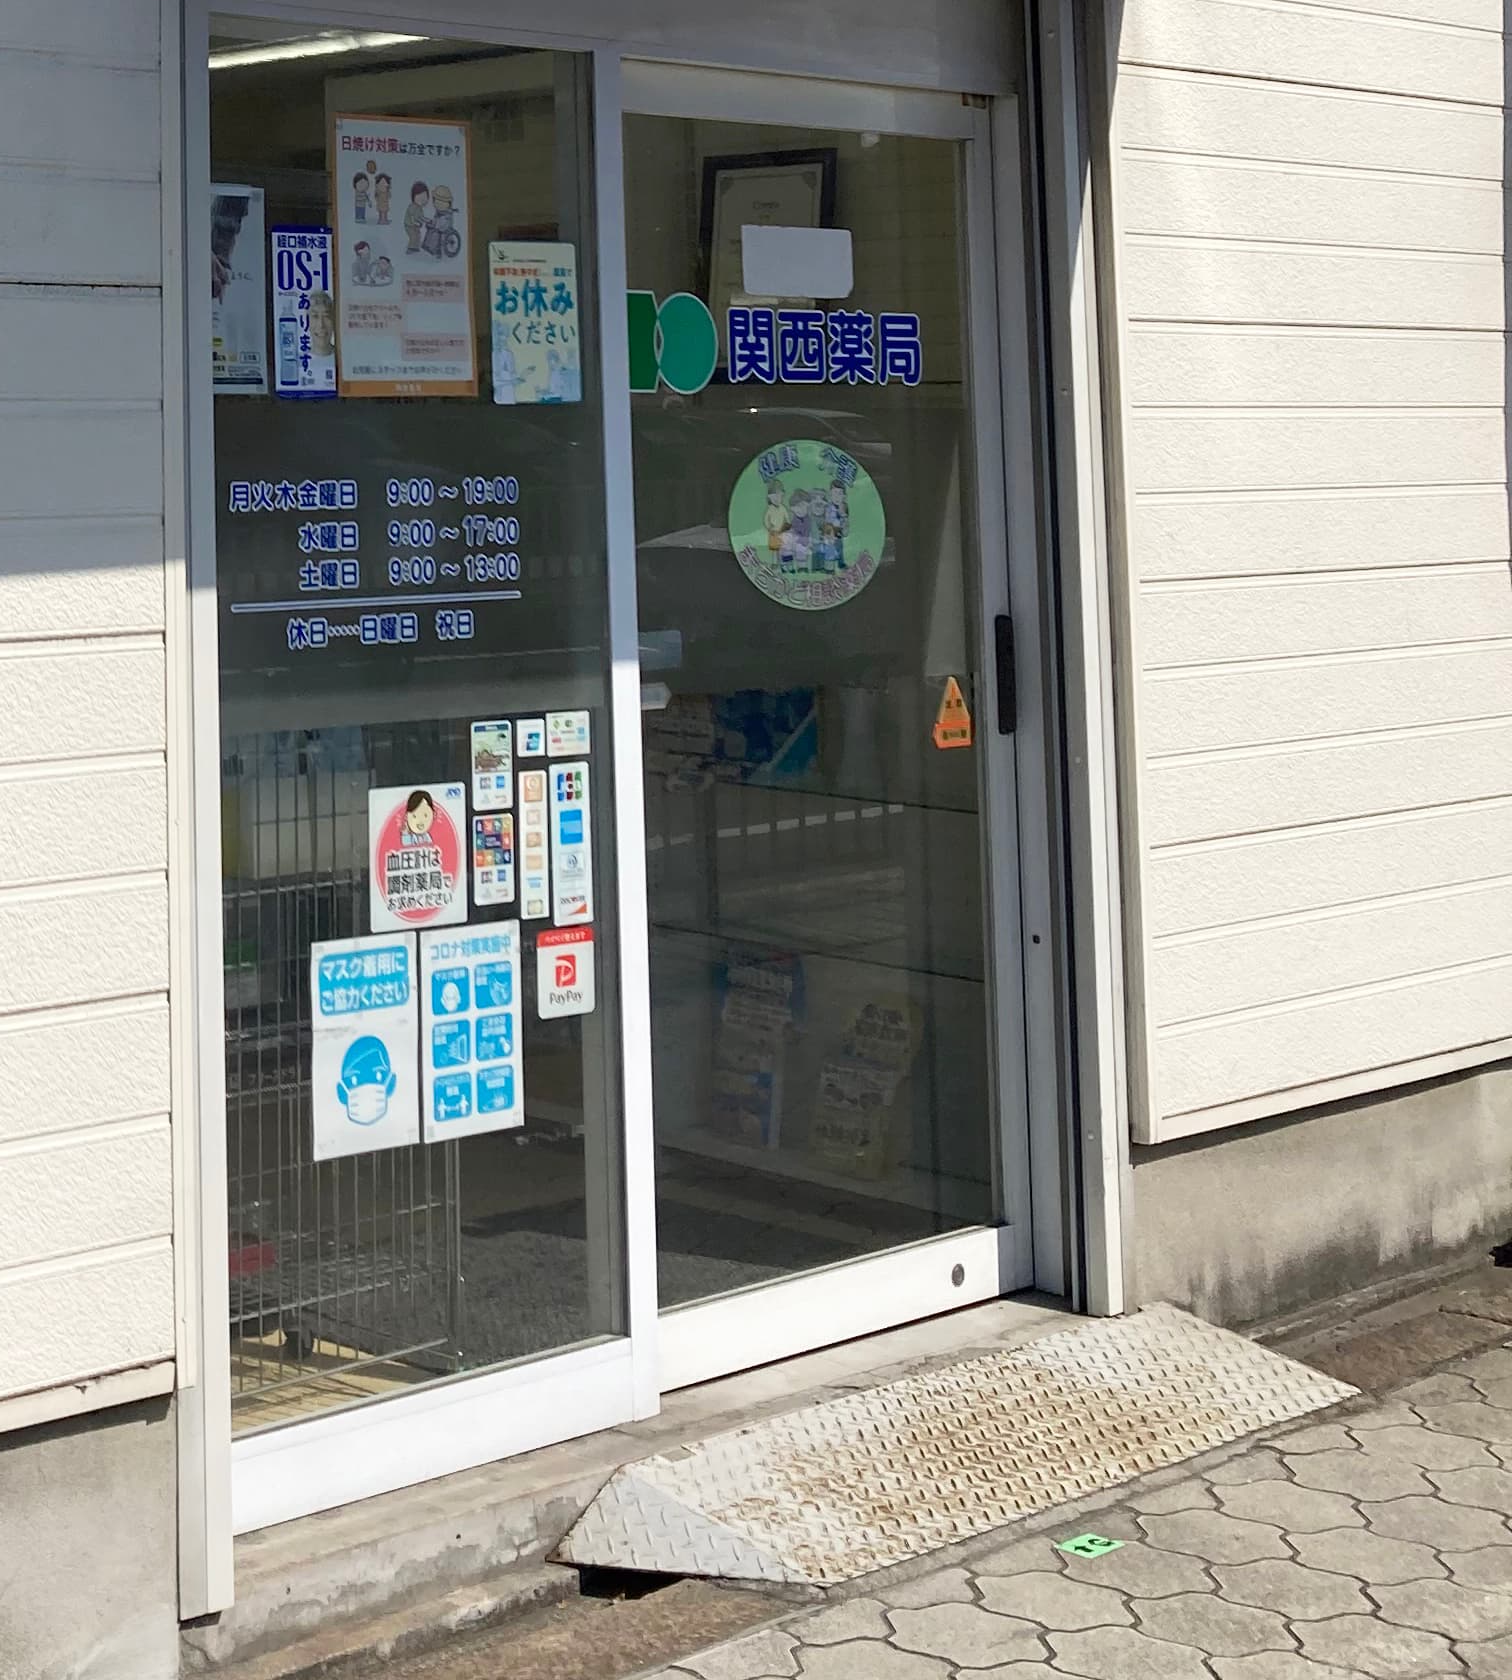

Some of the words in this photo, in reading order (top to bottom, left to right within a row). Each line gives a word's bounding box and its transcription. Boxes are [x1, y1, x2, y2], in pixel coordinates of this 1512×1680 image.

[277, 249, 328, 291] OS-1
[494, 278, 575, 317] お休み
[511, 321, 576, 345] ください
[727, 307, 921, 385] 関西薬局
[229, 479, 357, 512] 月火木金曜日
[298, 521, 358, 553] 水曜日
[299, 559, 359, 591] 土曜日
[435, 609, 474, 640] 祝日
[387, 848, 442, 871] 血圧計は
[550, 989, 583, 1006] PayPay
